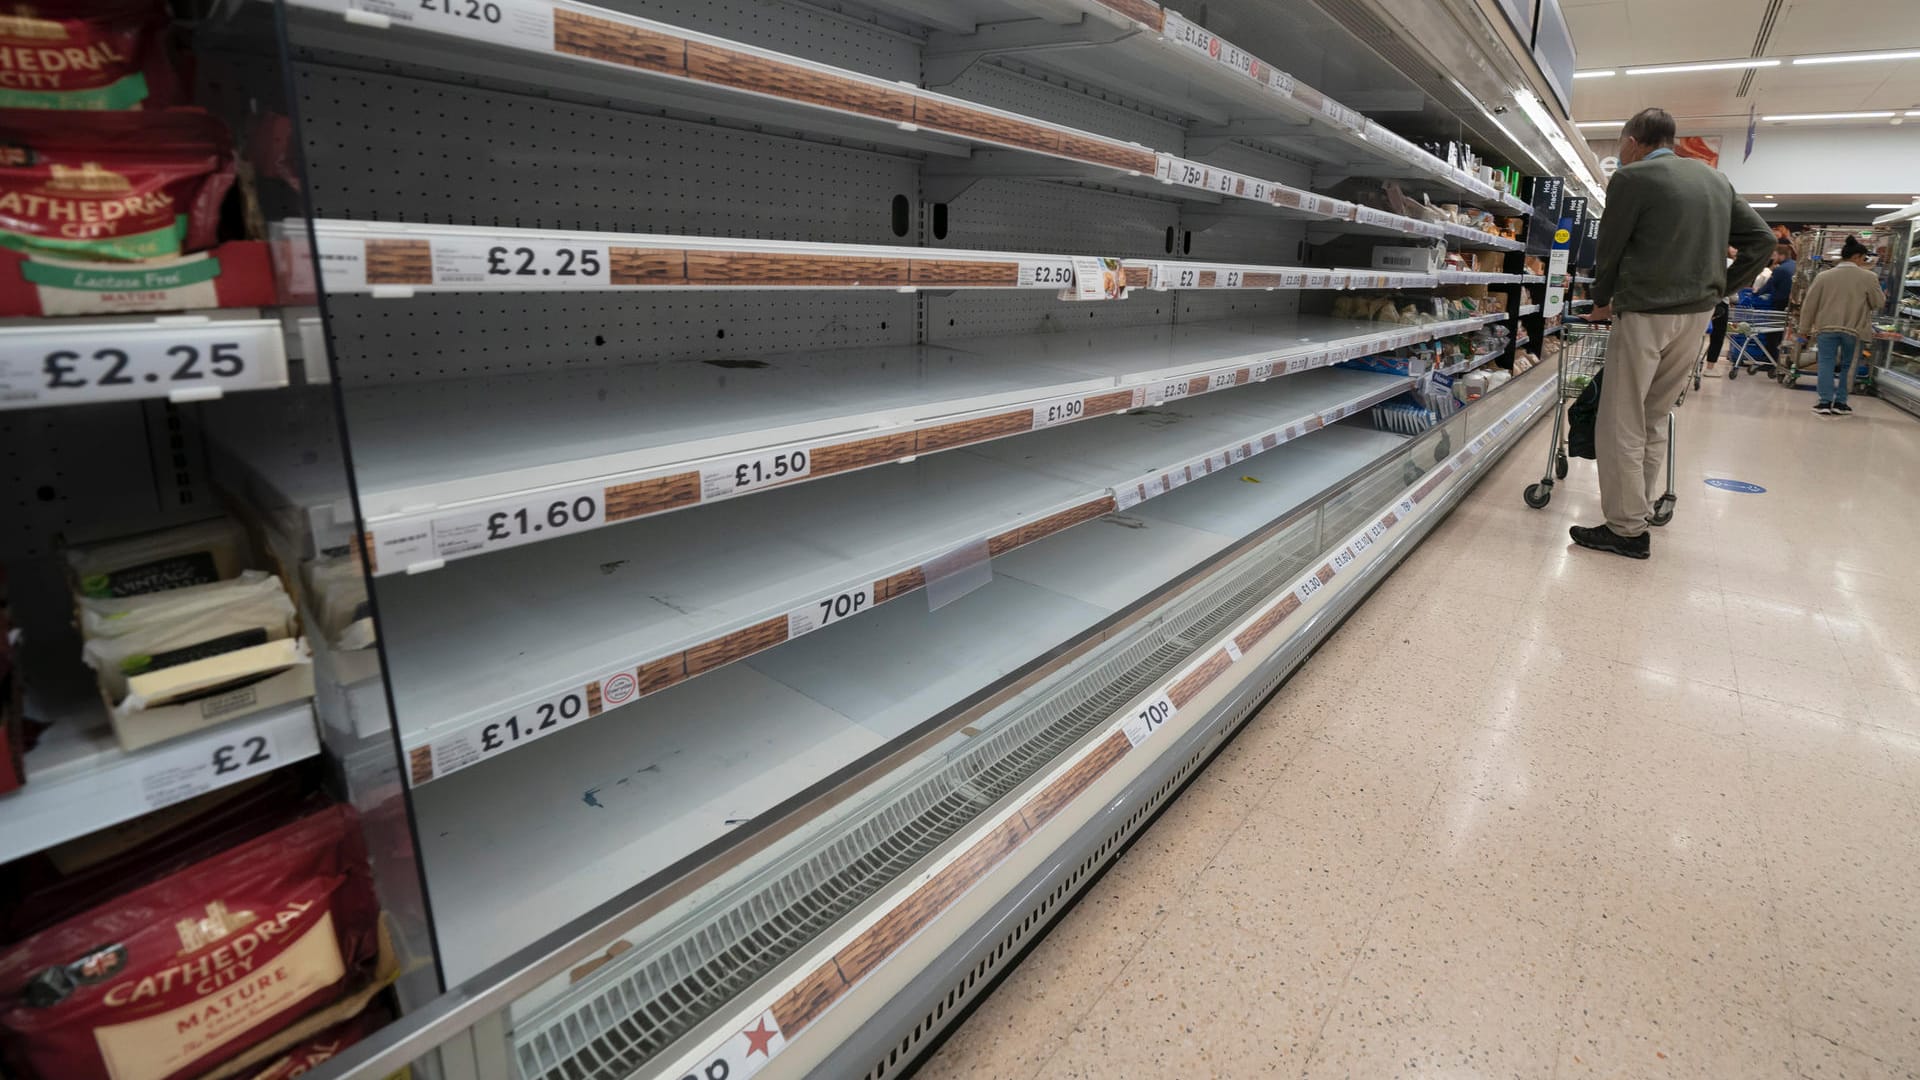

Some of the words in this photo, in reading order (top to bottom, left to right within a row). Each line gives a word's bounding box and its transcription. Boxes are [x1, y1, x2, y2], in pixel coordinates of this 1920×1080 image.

[1185, 26, 1209, 50] £1.65
[1, 73, 60, 88] CITY
[1221, 175, 1231, 192] £1
[1254, 183, 1264, 199] £1
[1543, 180, 1551, 193] Hot
[1548, 180, 1560, 210] Snacking
[61, 220, 117, 238] CITY
[488, 246, 601, 276] £2.25
[74, 272, 140, 288] Lactose
[145, 271, 181, 285] Free
[1035, 267, 1071, 283] £2.50
[1180, 270, 1193, 287] £2
[1227, 272, 1239, 287] £2
[43, 343, 244, 388] £2.25
[1164, 382, 1187, 398] £2.50
[1047, 400, 1081, 421] £1.90
[735, 451, 806, 487] £1.50
[487, 496, 596, 541] £1.60
[820, 590, 866, 624] 70p
[481, 694, 582, 752] £1.20
[1139, 701, 1168, 732] 70p
[212, 736, 270, 775] £2
[103, 899, 314, 1007] CATHEDRAL
[197, 957, 254, 995] CITY
[176, 967, 289, 1034] MATURE
